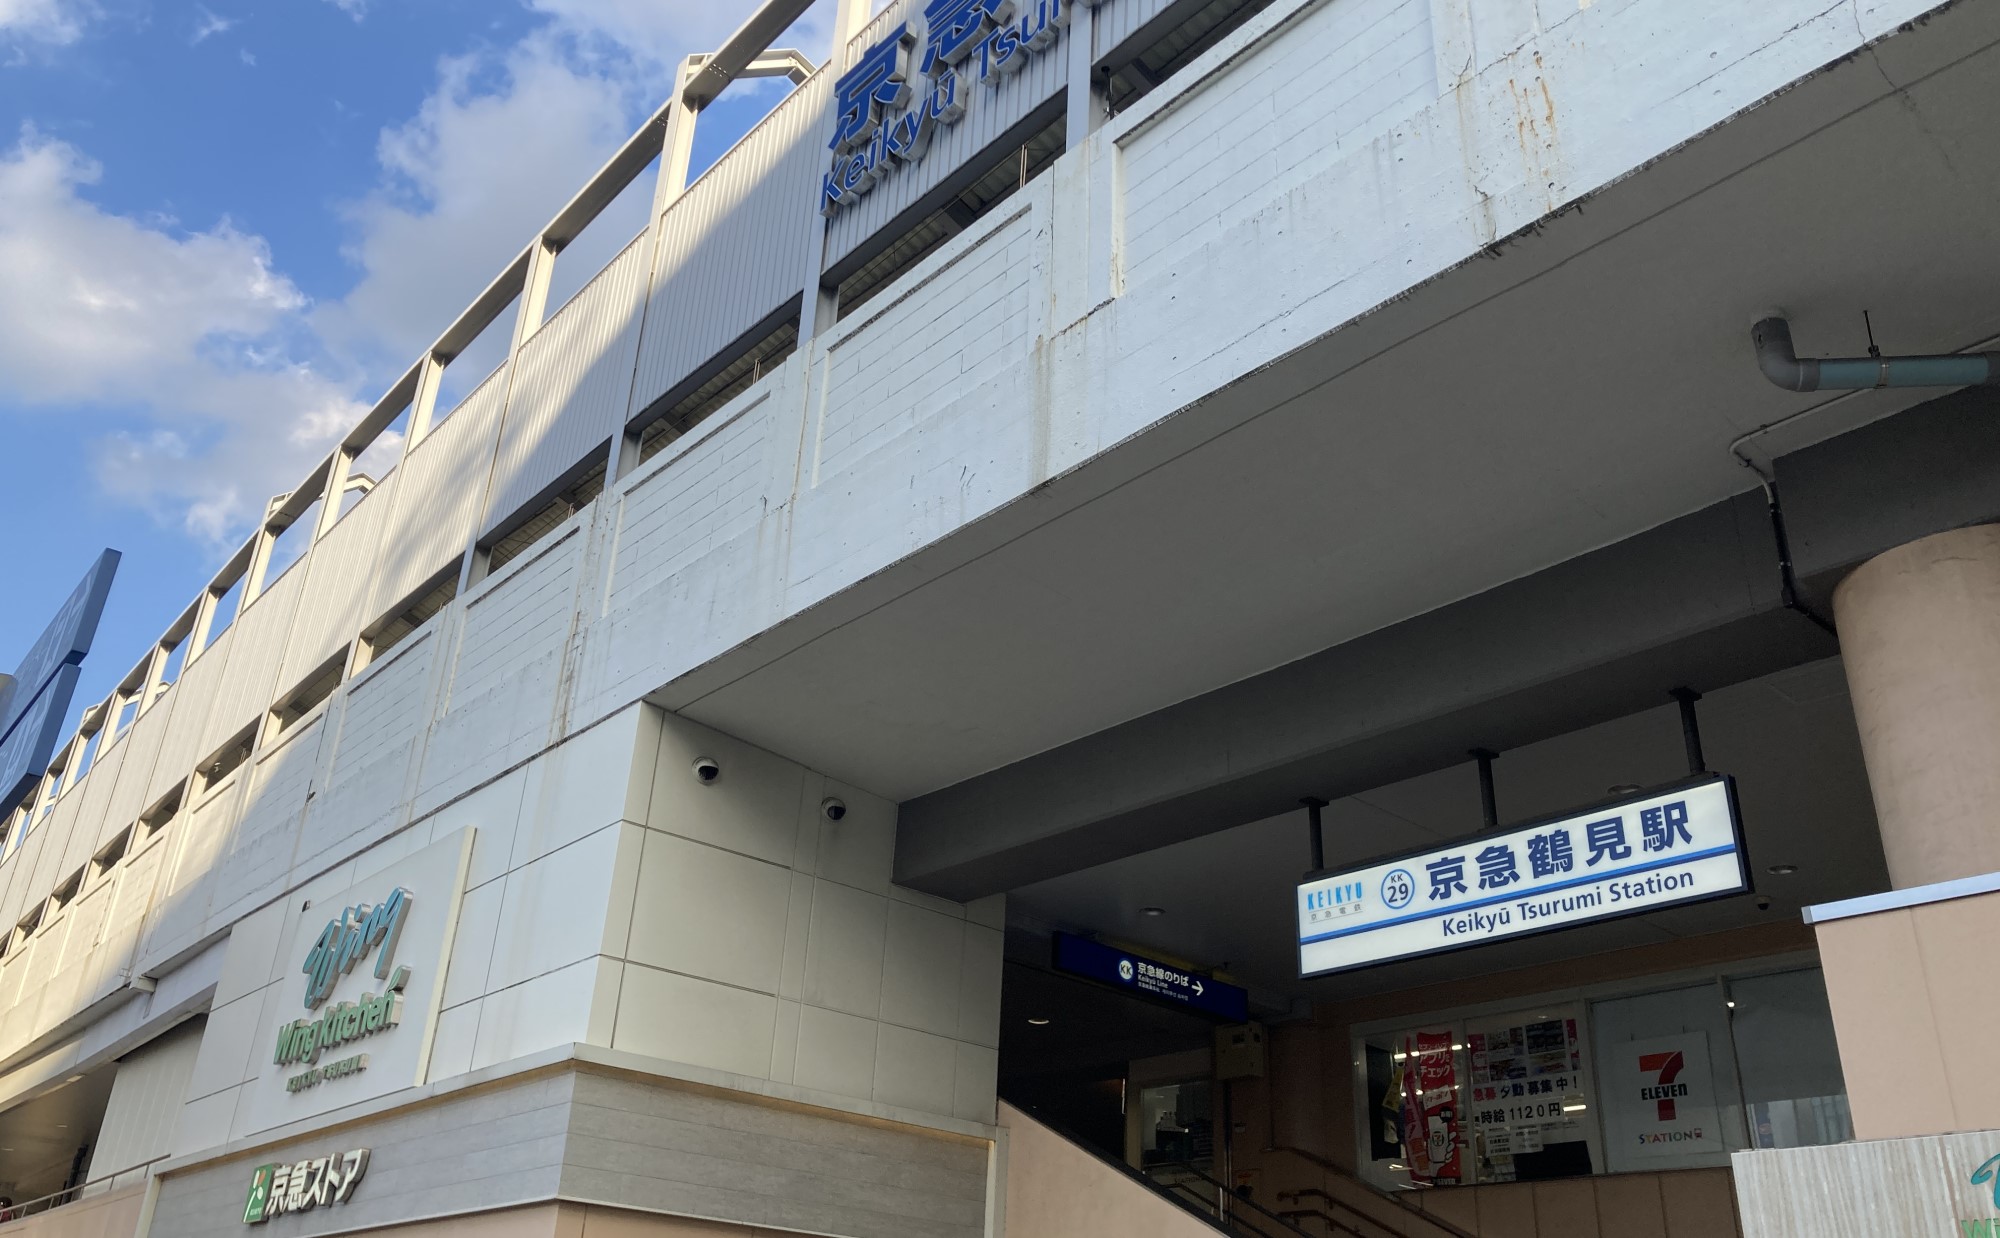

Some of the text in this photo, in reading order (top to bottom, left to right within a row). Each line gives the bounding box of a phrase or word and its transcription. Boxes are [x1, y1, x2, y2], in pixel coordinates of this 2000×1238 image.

[820, 69, 956, 212] Keikyū
[1426, 800, 1693, 902] 京急鶴見駅
[1307, 881, 1363, 911] KEIKYU
[1387, 882, 1409, 904] 29
[1390, 873, 1404, 884] KK
[1442, 869, 1694, 937] Keikyū Tsurumi Station
[302, 886, 412, 1010] Wing
[1120, 964, 1132, 976] KK
[1137, 962, 1189, 987] 京急線のりば
[273, 1017, 321, 1064] Wing
[1638, 1130, 1693, 1145] STATION
[264, 1148, 366, 1216] 京急ストア
